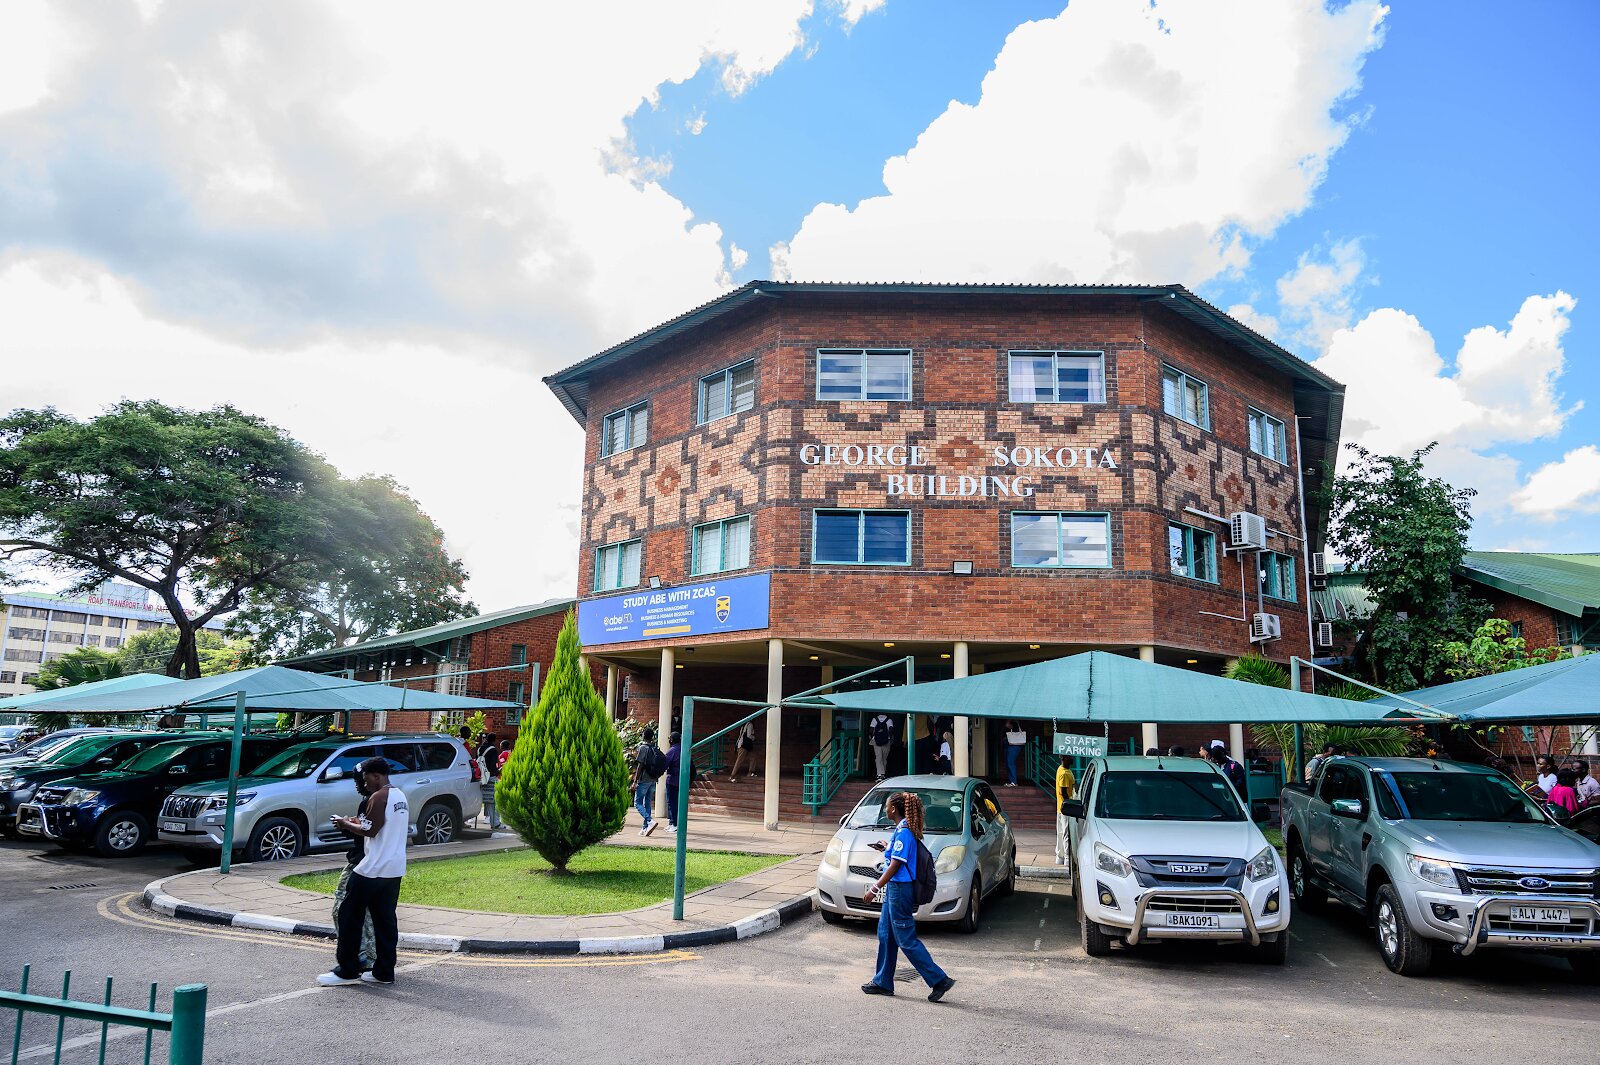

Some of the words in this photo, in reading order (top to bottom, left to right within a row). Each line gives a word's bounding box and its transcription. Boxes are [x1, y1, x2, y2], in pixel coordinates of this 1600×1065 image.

[799, 444, 928, 467] GEORGE
[994, 445, 1118, 469] SOKOTA
[886, 474, 1035, 497] BUILDING
[87, 596, 104, 605] ROAD
[107, 598, 140, 609] TRANSPORT
[623, 596, 649, 609] STUDY
[649, 593, 666, 605] ABE
[667, 589, 691, 602] WITH
[692, 585, 716, 600] ZCAS
[646, 607, 664, 615] BUSINESS
[609, 615, 622, 625] abe
[1064, 735, 1099, 746] STAFF
[1058, 745, 1102, 757] PARKING
[1171, 865, 1208, 873] ISUZU
[1518, 908, 1536, 920] ALV
[1541, 909, 1563, 921] 1447
[1172, 915, 1213, 927] BAK1091
